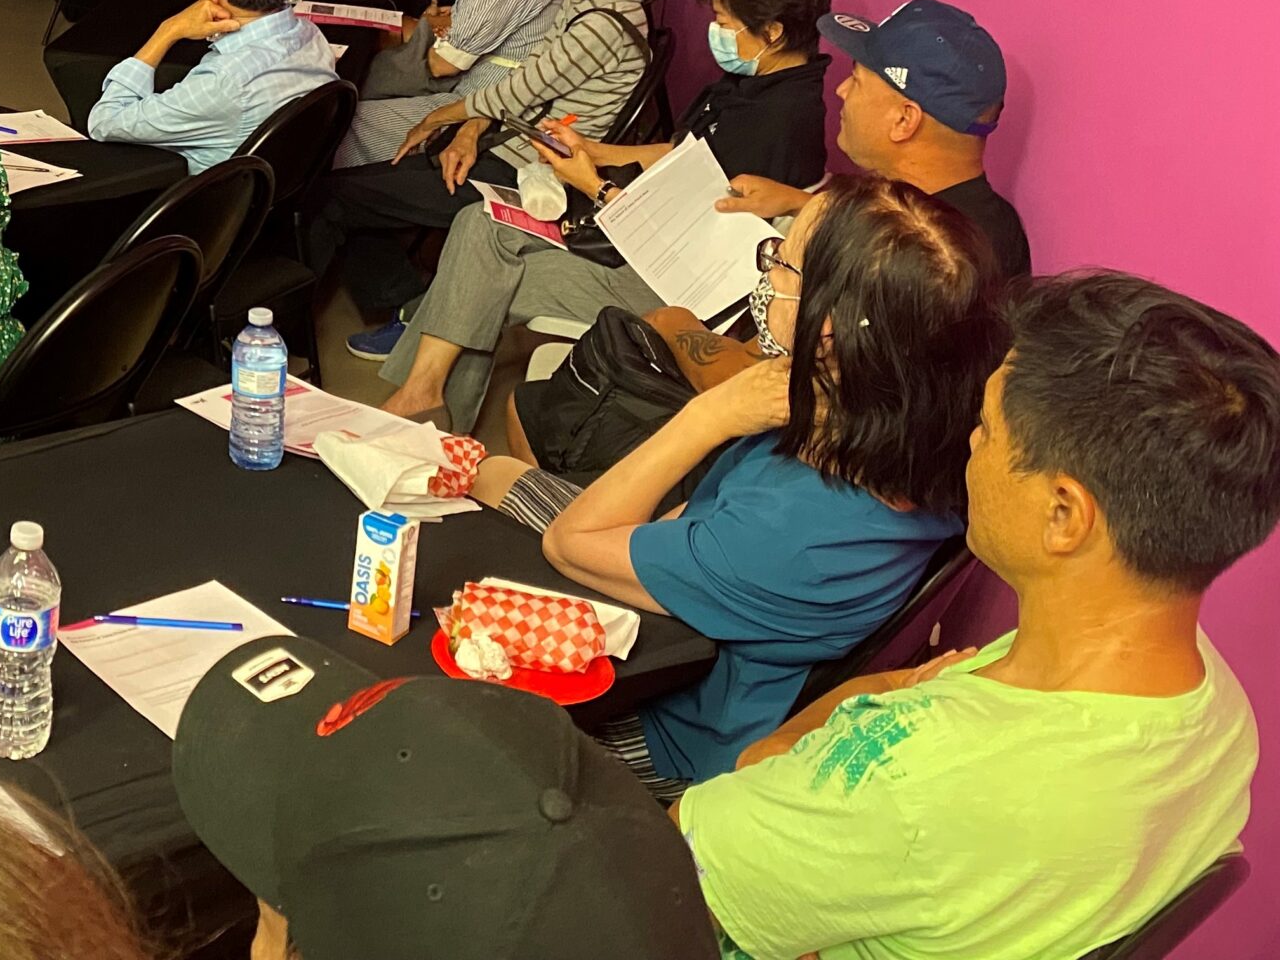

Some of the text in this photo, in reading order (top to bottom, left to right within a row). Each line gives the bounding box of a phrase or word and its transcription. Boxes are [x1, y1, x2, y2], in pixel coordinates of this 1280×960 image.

[355, 554, 372, 606] OASIS
[8, 616, 33, 628] Pure
[10, 626, 29, 639] Life
